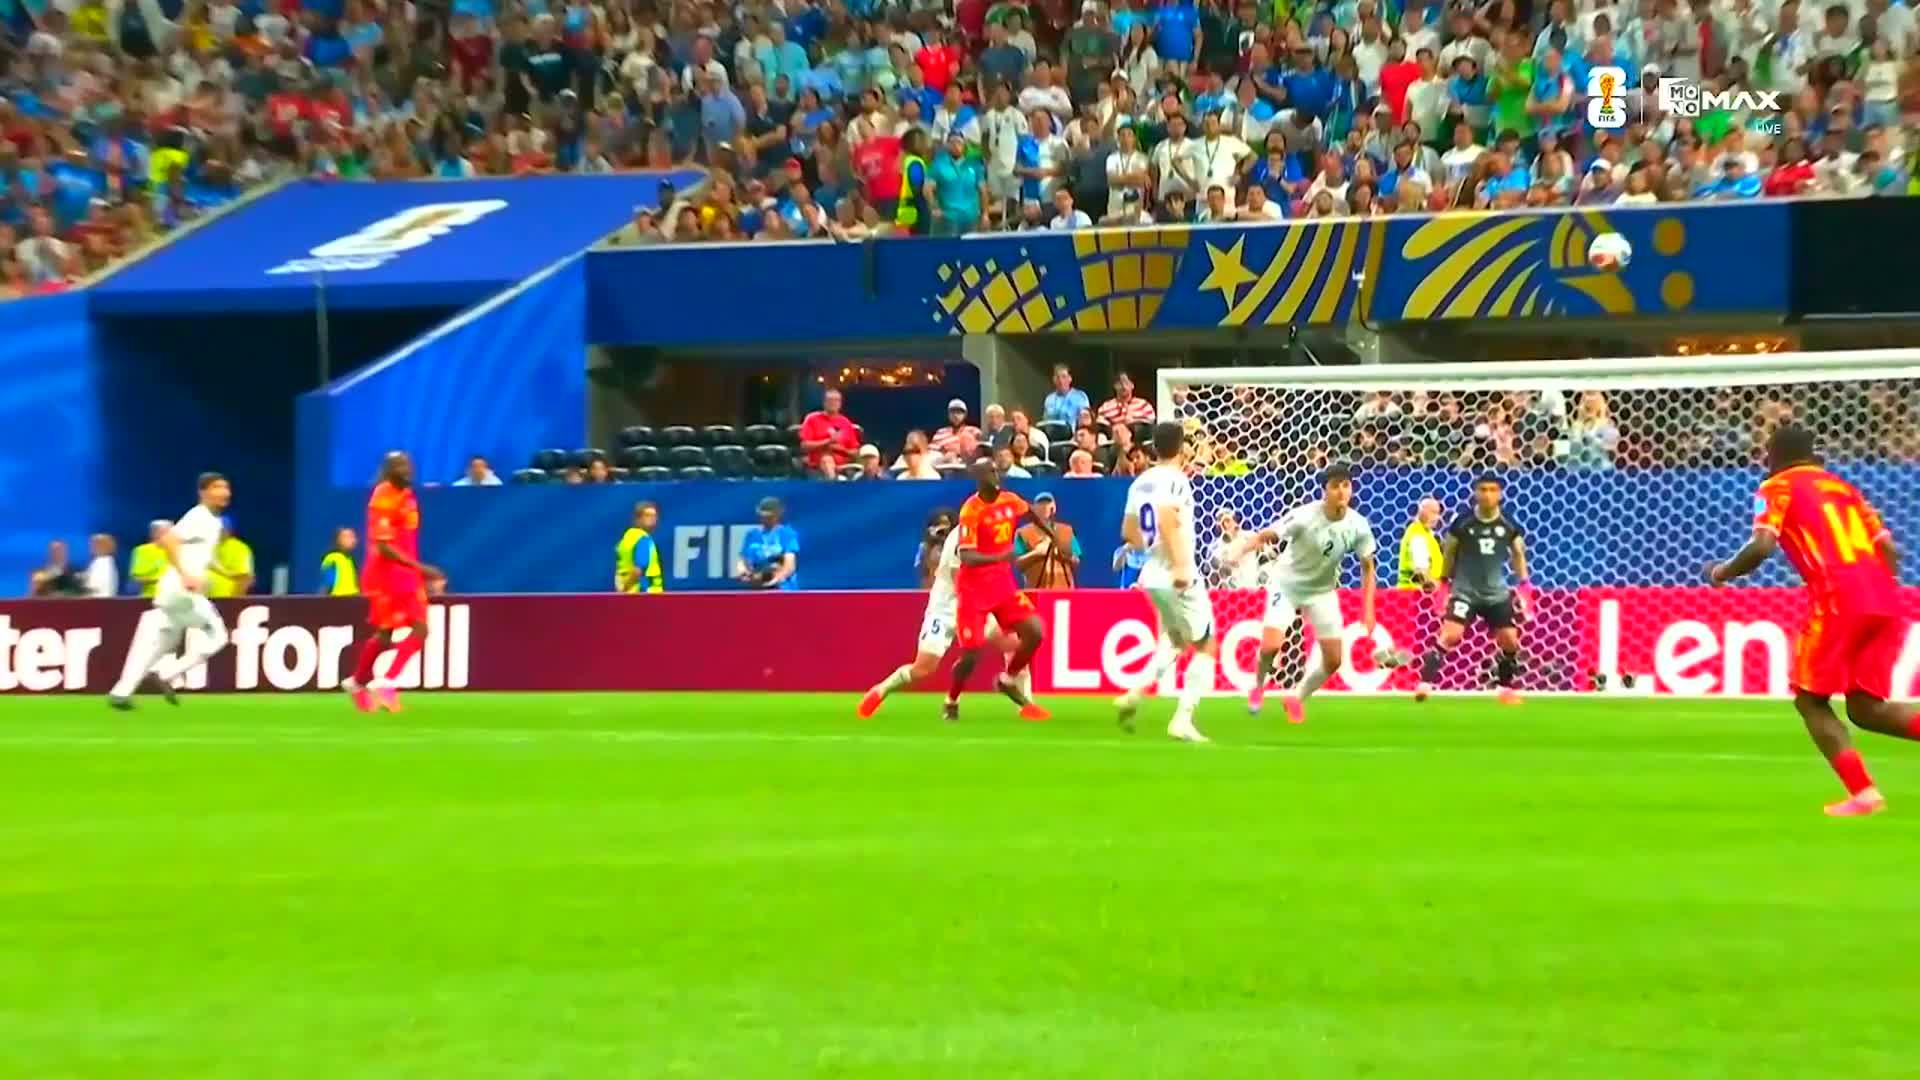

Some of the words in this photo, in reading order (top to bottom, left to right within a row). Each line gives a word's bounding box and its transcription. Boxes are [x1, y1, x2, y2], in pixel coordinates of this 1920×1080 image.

[994, 521, 1011, 544] 20
[1140, 503, 1156, 547] 9
[1822, 502, 1874, 564] 14
[1323, 540, 1334, 557] 2
[1478, 537, 1496, 555] 12
[230, 606, 354, 690] for
[371, 604, 469, 690] all
